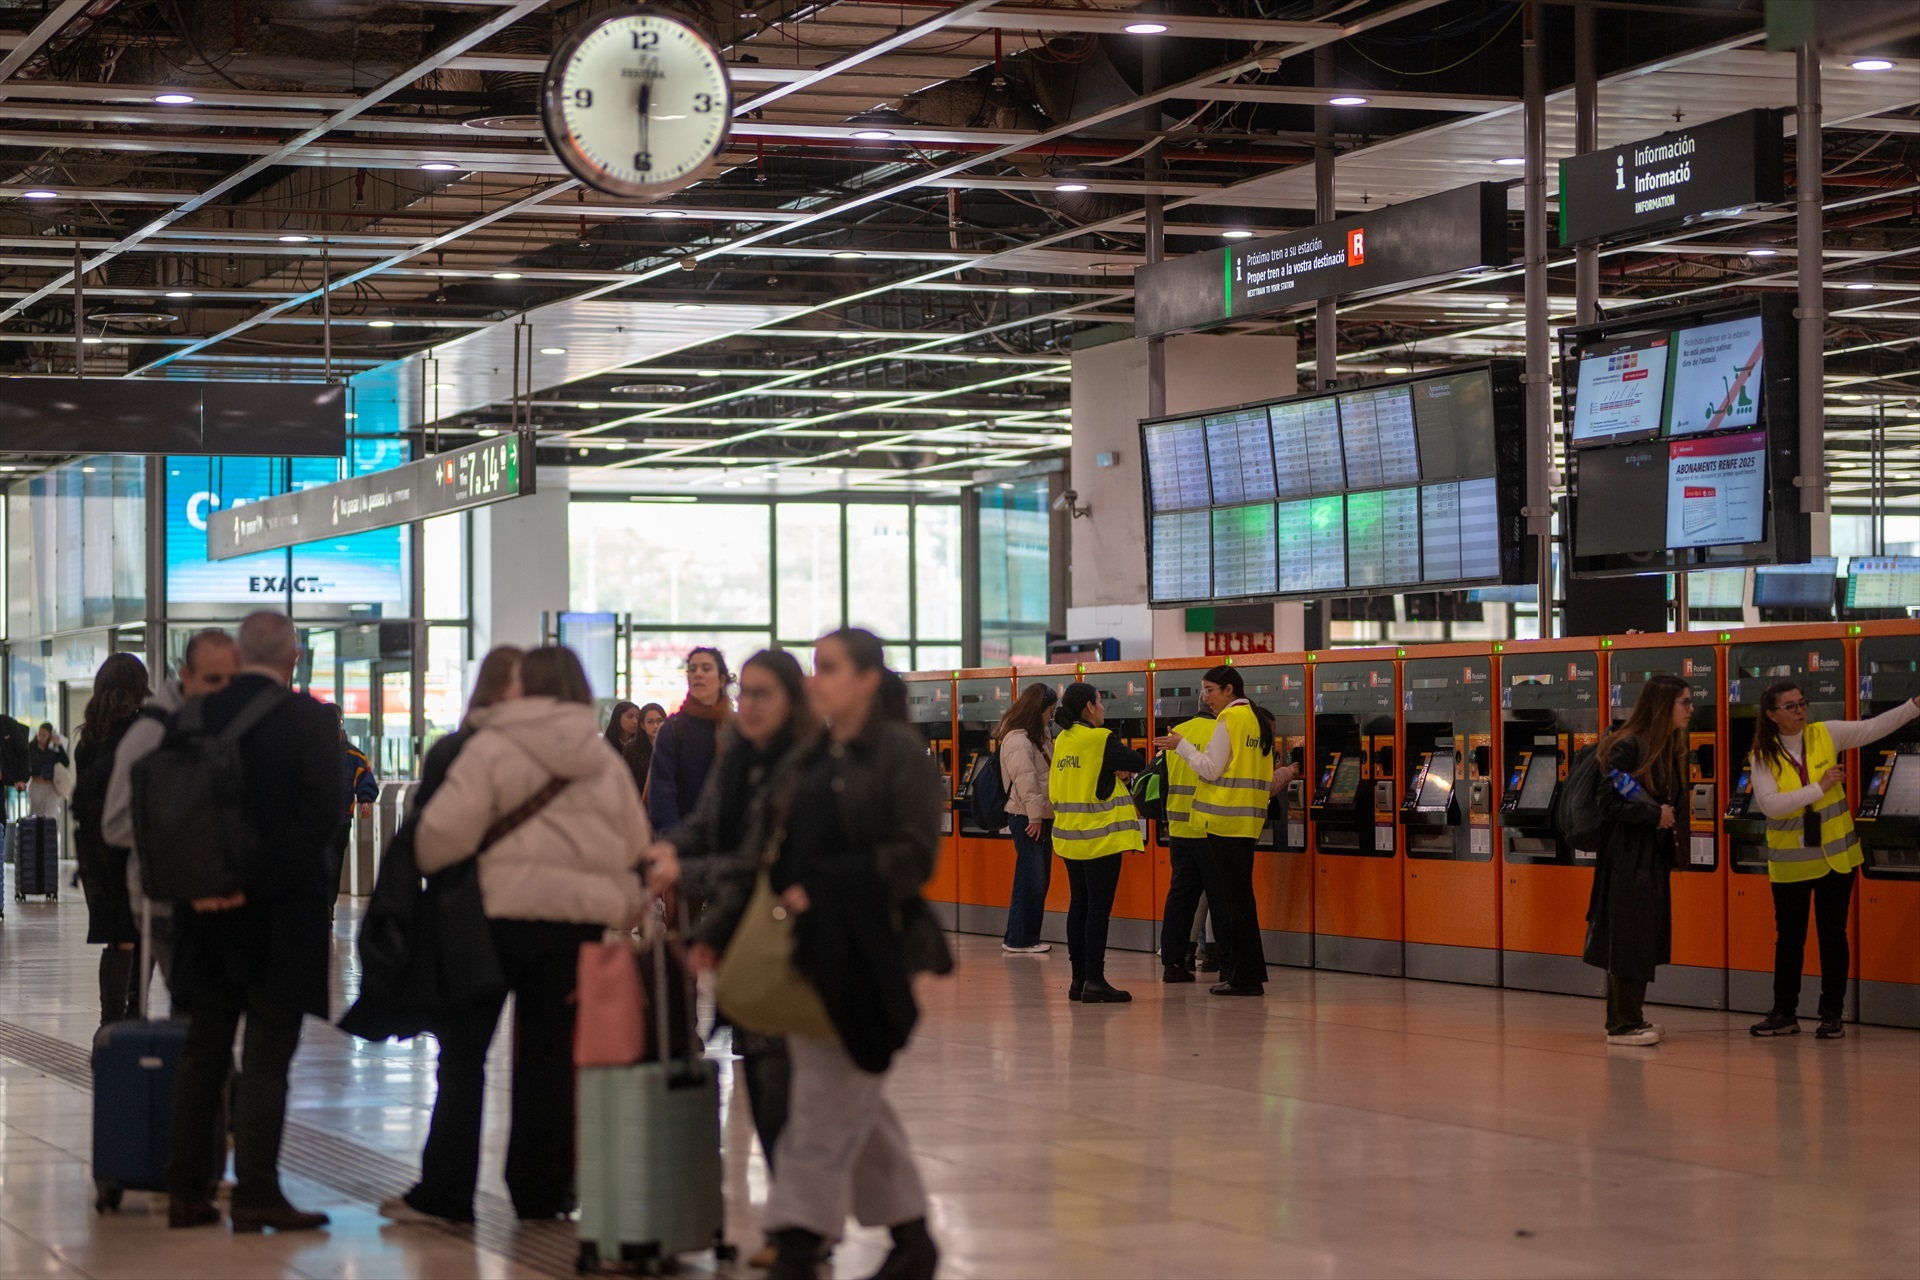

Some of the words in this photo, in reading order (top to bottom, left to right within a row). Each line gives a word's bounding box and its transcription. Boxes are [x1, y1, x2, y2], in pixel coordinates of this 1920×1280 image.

[630, 30, 659, 50] 12
[575, 88, 592, 108] 9
[694, 93, 711, 113] 3
[1635, 135, 1695, 167] Información
[634, 152, 652, 171] 6
[1635, 161, 1691, 193] Informació
[1635, 194, 1675, 214] INFORMATION
[1246, 252, 1270, 267] Próximo
[1271, 249, 1284, 261] tren
[1284, 248, 1289, 258] a
[1290, 246, 1297, 257] su
[1298, 237, 1322, 255] estación
[1354, 233, 1364, 256] R
[1246, 271, 1266, 285] Proper
[1267, 268, 1280, 280] tren
[1281, 266, 1286, 277] a
[1286, 262, 1292, 276] la
[1293, 260, 1312, 274] vostra
[1313, 249, 1345, 270] destinació
[1280, 280, 1294, 290] STATION
[482, 446, 499, 494] 14
[1676, 460, 1717, 475] ABONAMENTS
[1718, 458, 1738, 470] RENFE
[1738, 457, 1755, 468] 2025
[1694, 688, 1708, 700] renfe
[1820, 683, 1836, 695] renfe
